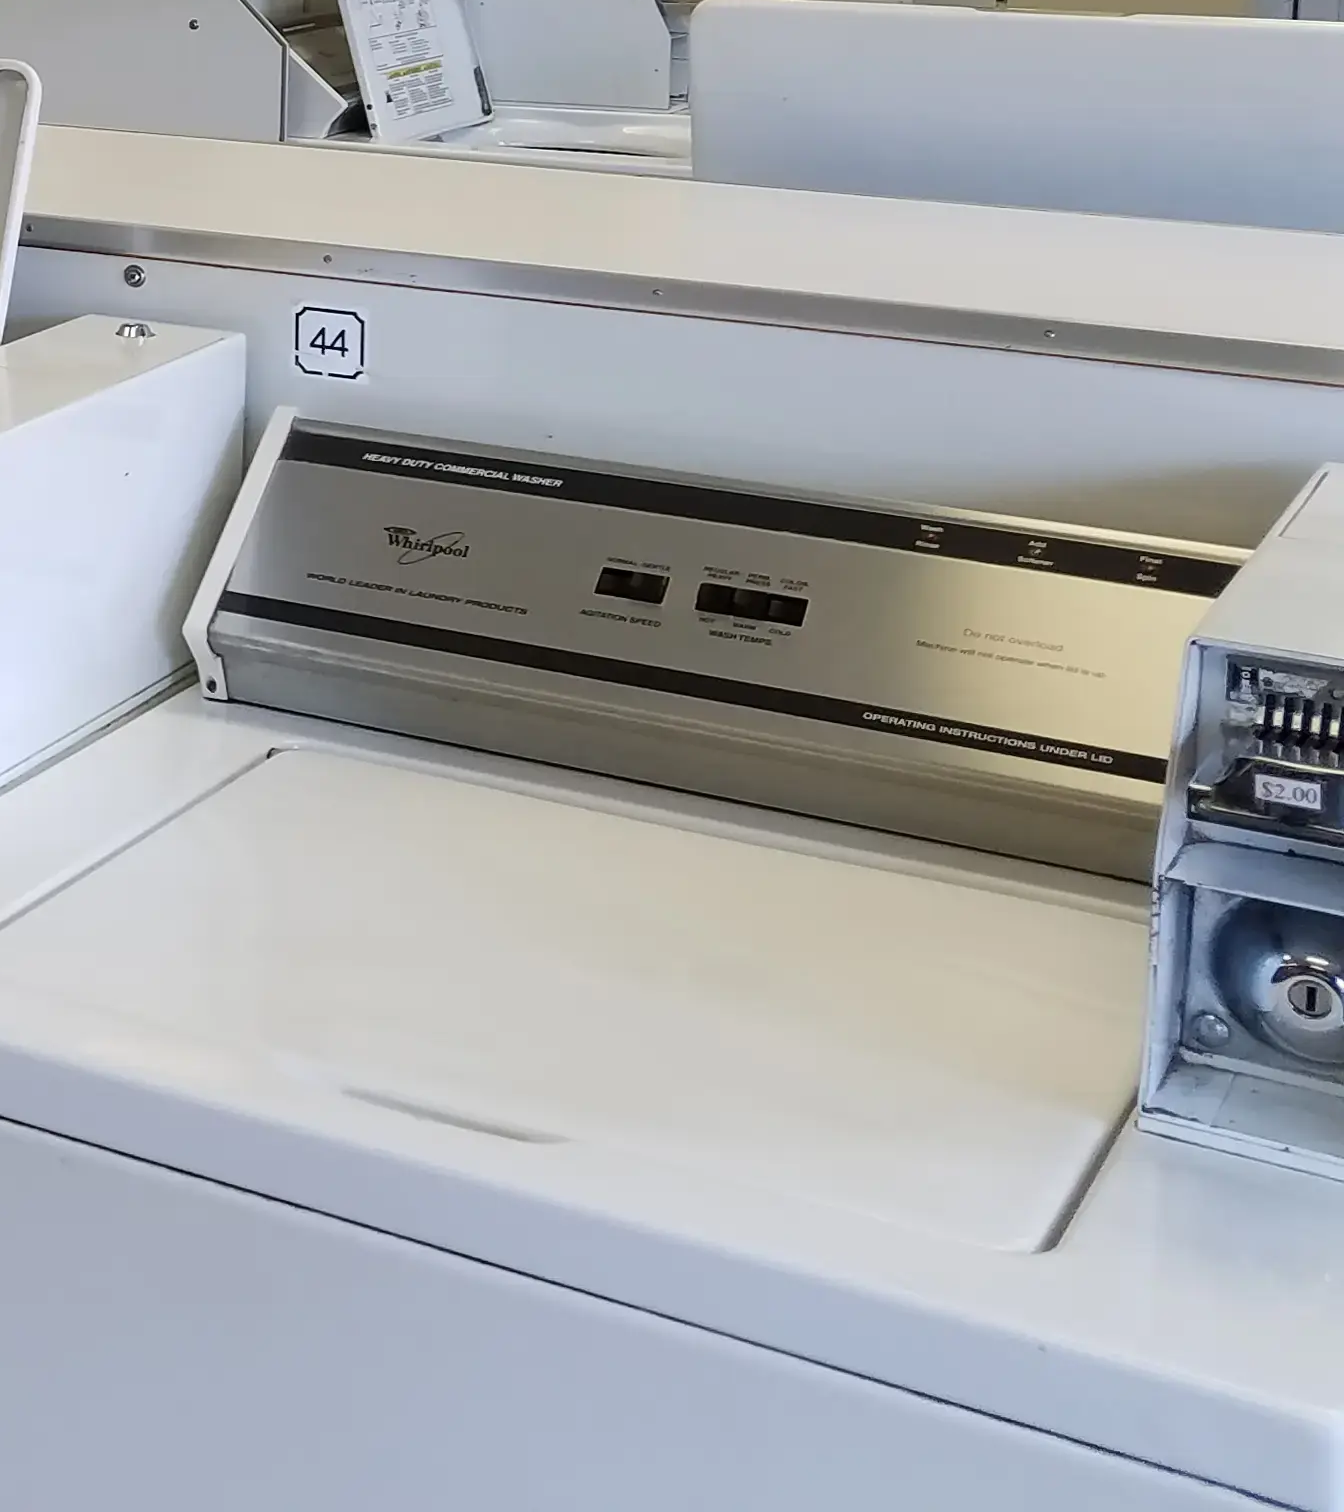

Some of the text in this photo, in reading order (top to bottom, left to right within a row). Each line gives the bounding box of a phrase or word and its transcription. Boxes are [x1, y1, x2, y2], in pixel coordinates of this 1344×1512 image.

[310, 327, 349, 357] 44
[362, 452, 563, 488] HEAVY DUTY COMMERCIAL WASHER
[388, 532, 469, 558] Whirlpool
[307, 572, 528, 615] WORLD LEADER IN LAUNDRY PRODUCTS
[863, 711, 1113, 765] OPERATING INSTRUCTIONS UNDER LID
[1262, 781, 1317, 804] $2.00
